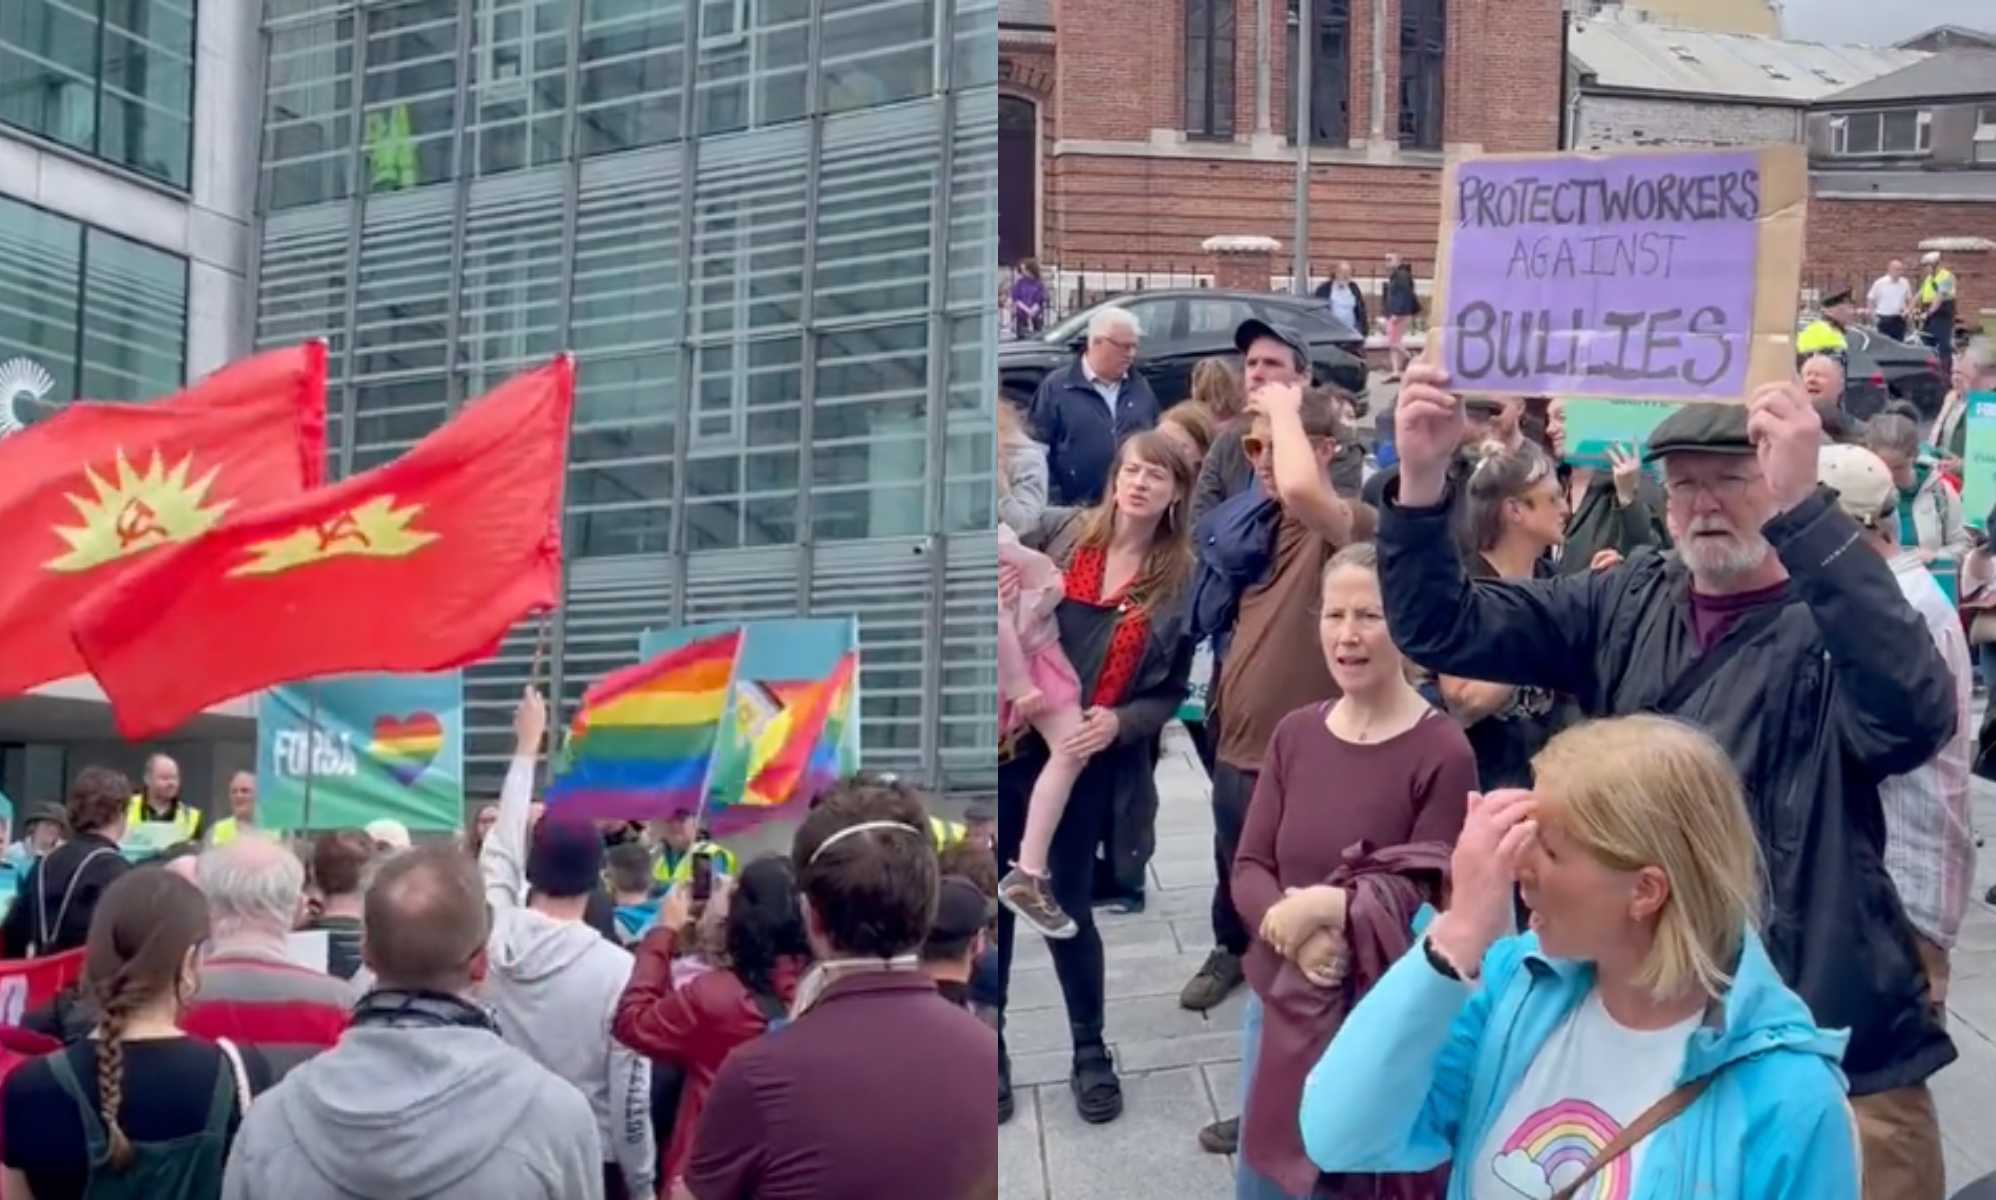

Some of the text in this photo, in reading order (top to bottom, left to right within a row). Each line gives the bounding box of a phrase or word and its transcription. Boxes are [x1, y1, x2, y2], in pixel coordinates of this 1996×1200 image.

[1457, 169, 1760, 228] PROTECT WORKERS
[1506, 232, 1687, 280] AGAINST
[1456, 300, 1732, 386] BULLIES
